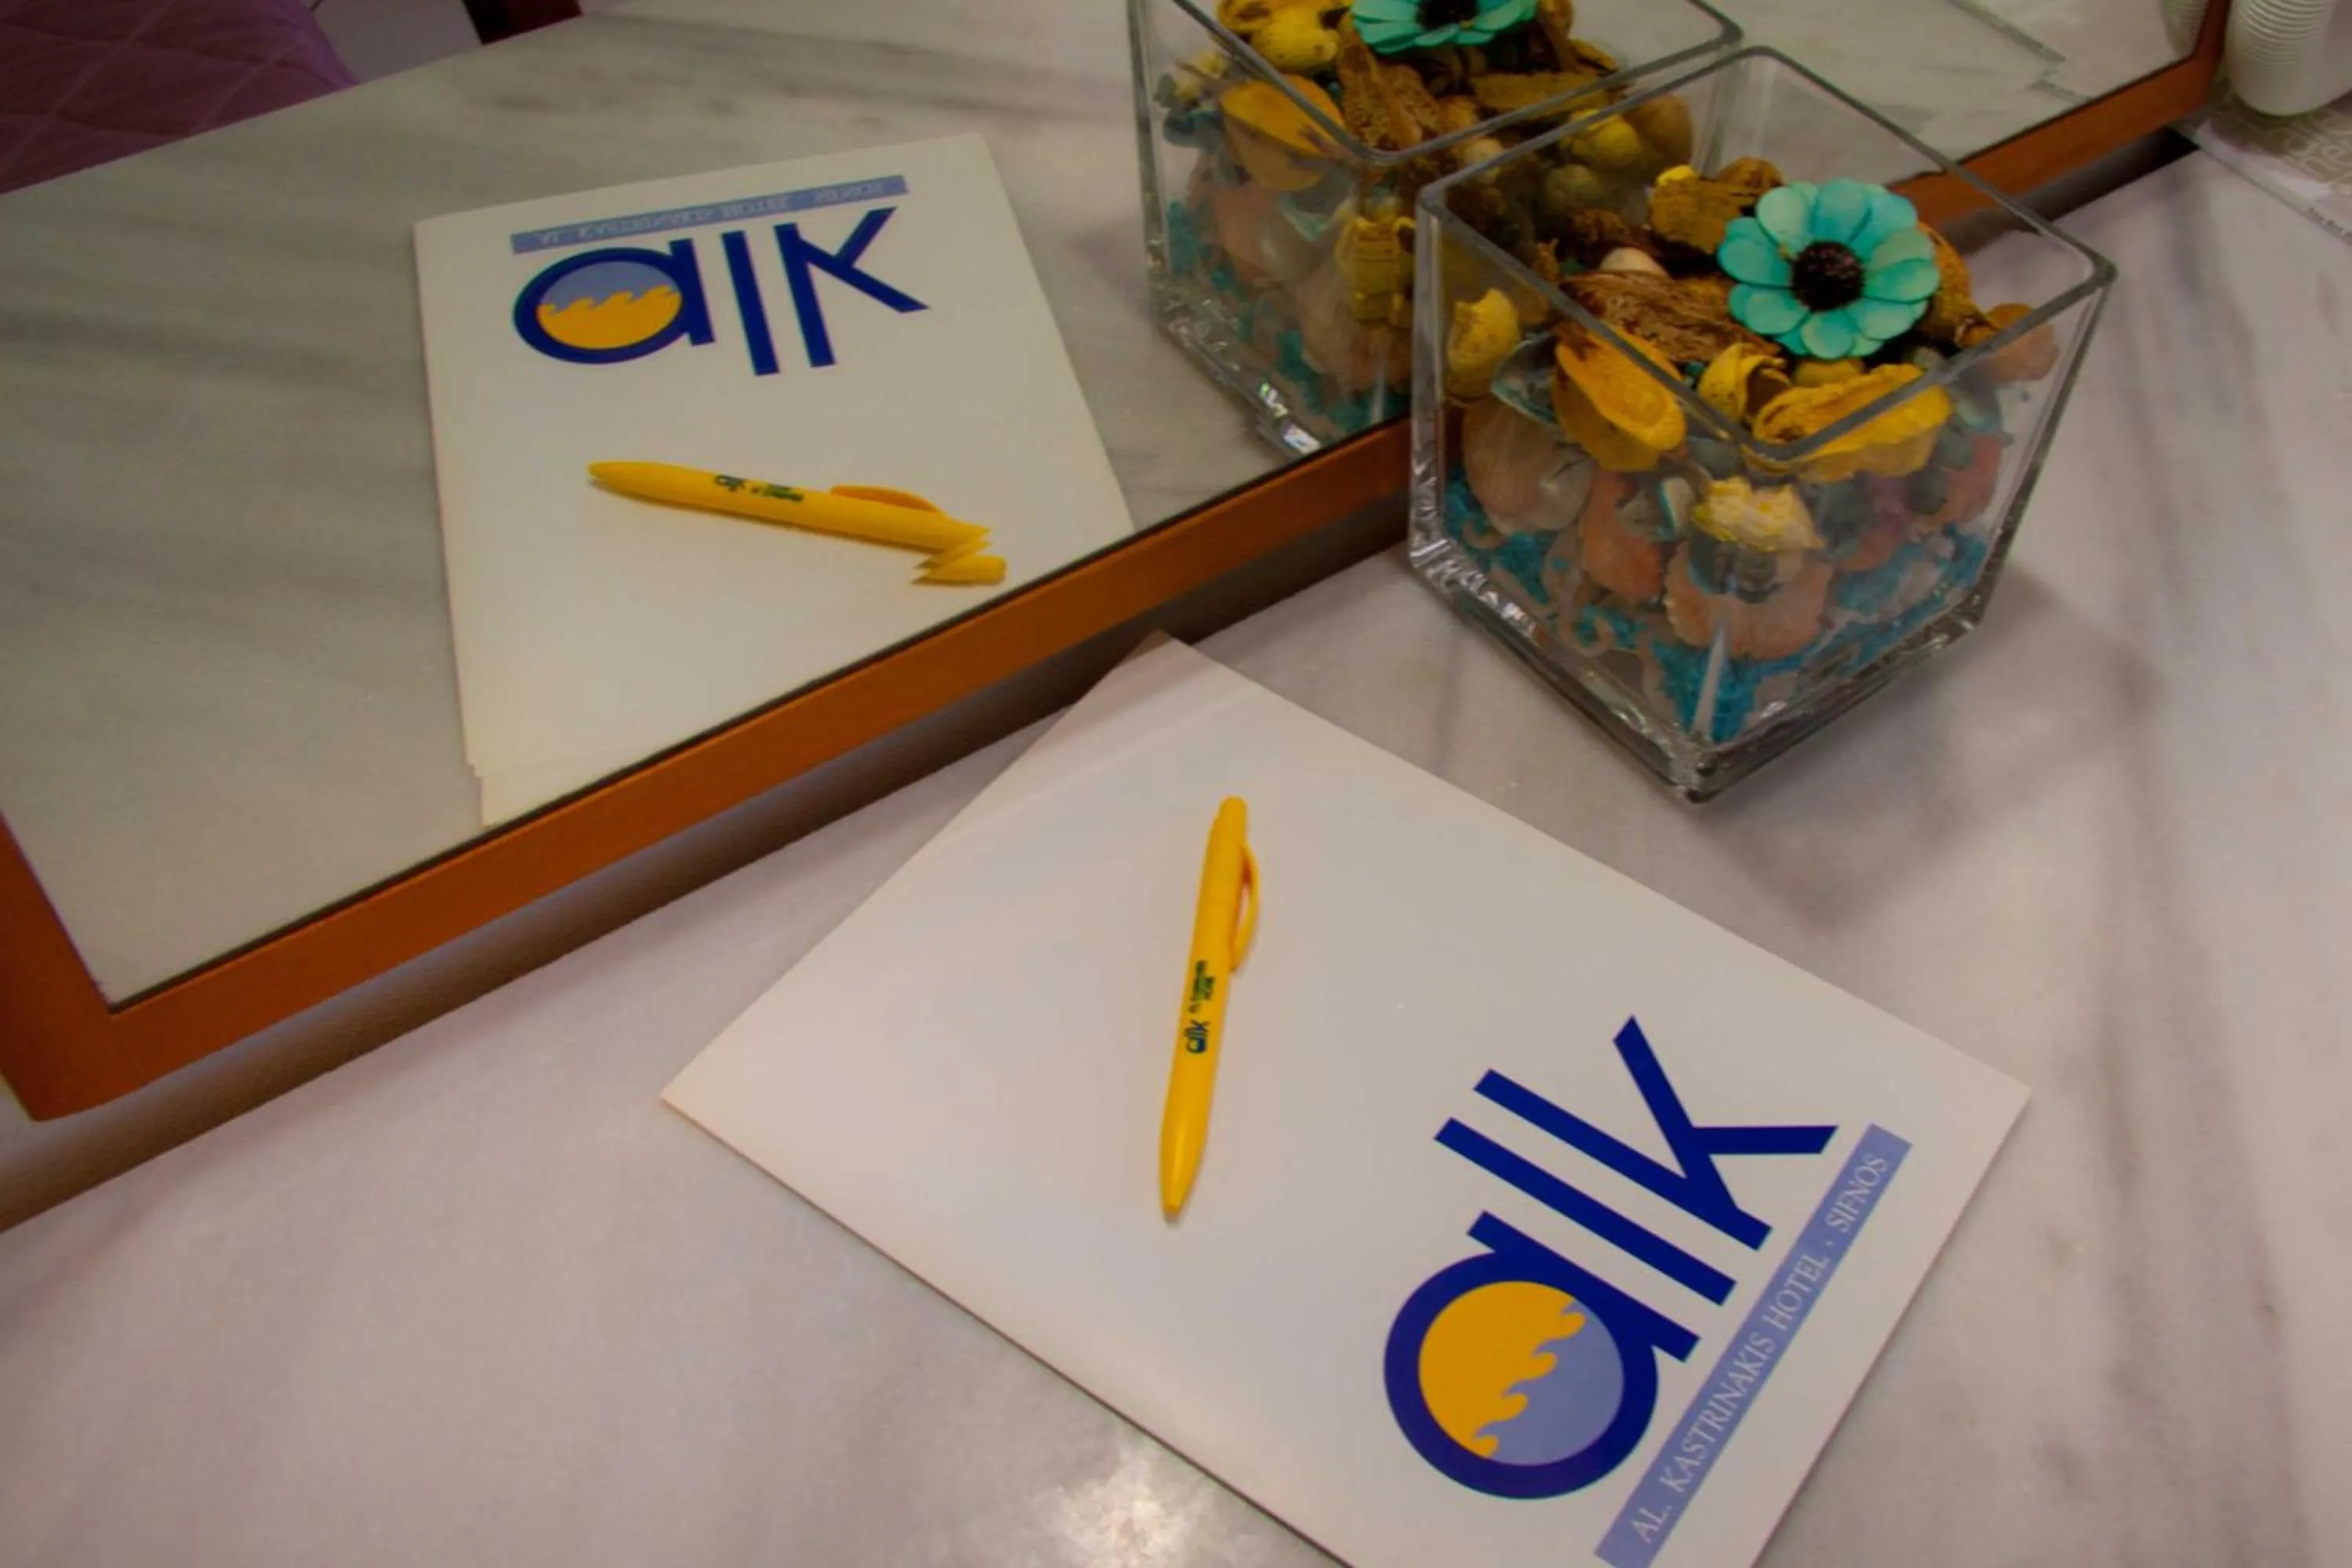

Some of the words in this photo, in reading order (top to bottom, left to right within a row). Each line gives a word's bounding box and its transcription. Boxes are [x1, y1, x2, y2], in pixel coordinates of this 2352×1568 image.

[1384, 1015, 1838, 1500] alk
[1631, 1502, 1674, 1544] AL.
[1659, 1331, 1777, 1494] KASTRINAKIS
[1762, 1253, 1831, 1331] HOTEL
[1825, 1153, 1889, 1233] SIFNOS
